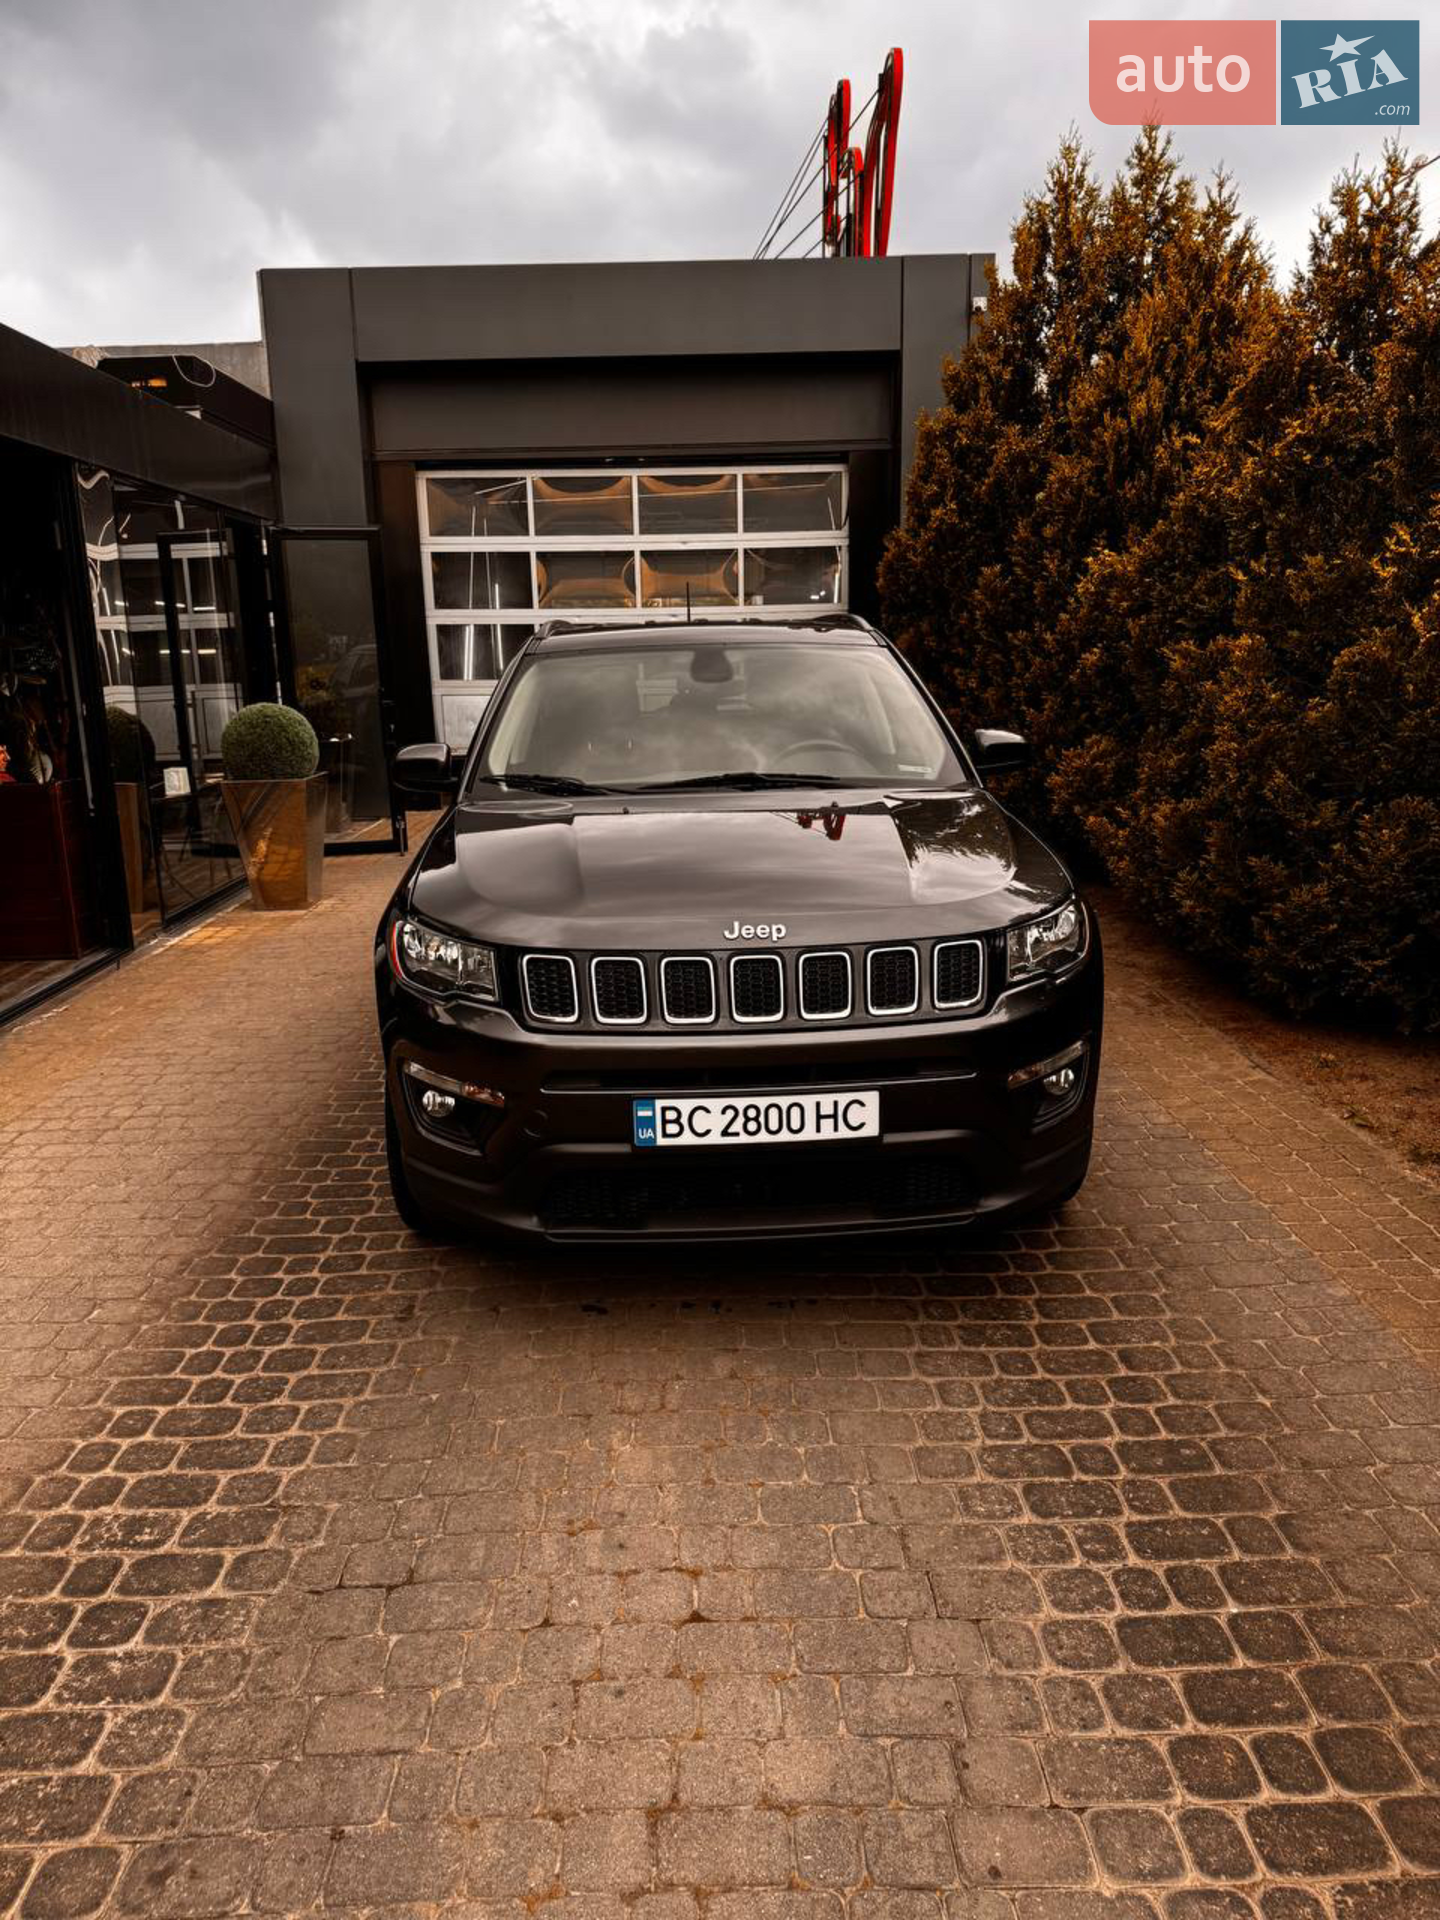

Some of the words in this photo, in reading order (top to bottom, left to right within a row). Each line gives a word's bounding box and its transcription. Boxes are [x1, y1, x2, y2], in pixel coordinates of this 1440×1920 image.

[723, 920, 787, 942] Jeep
[660, 1105, 712, 1138] BC
[720, 1102, 806, 1137] 2800
[815, 1099, 866, 1134] HC
[638, 1128, 655, 1139] UA
